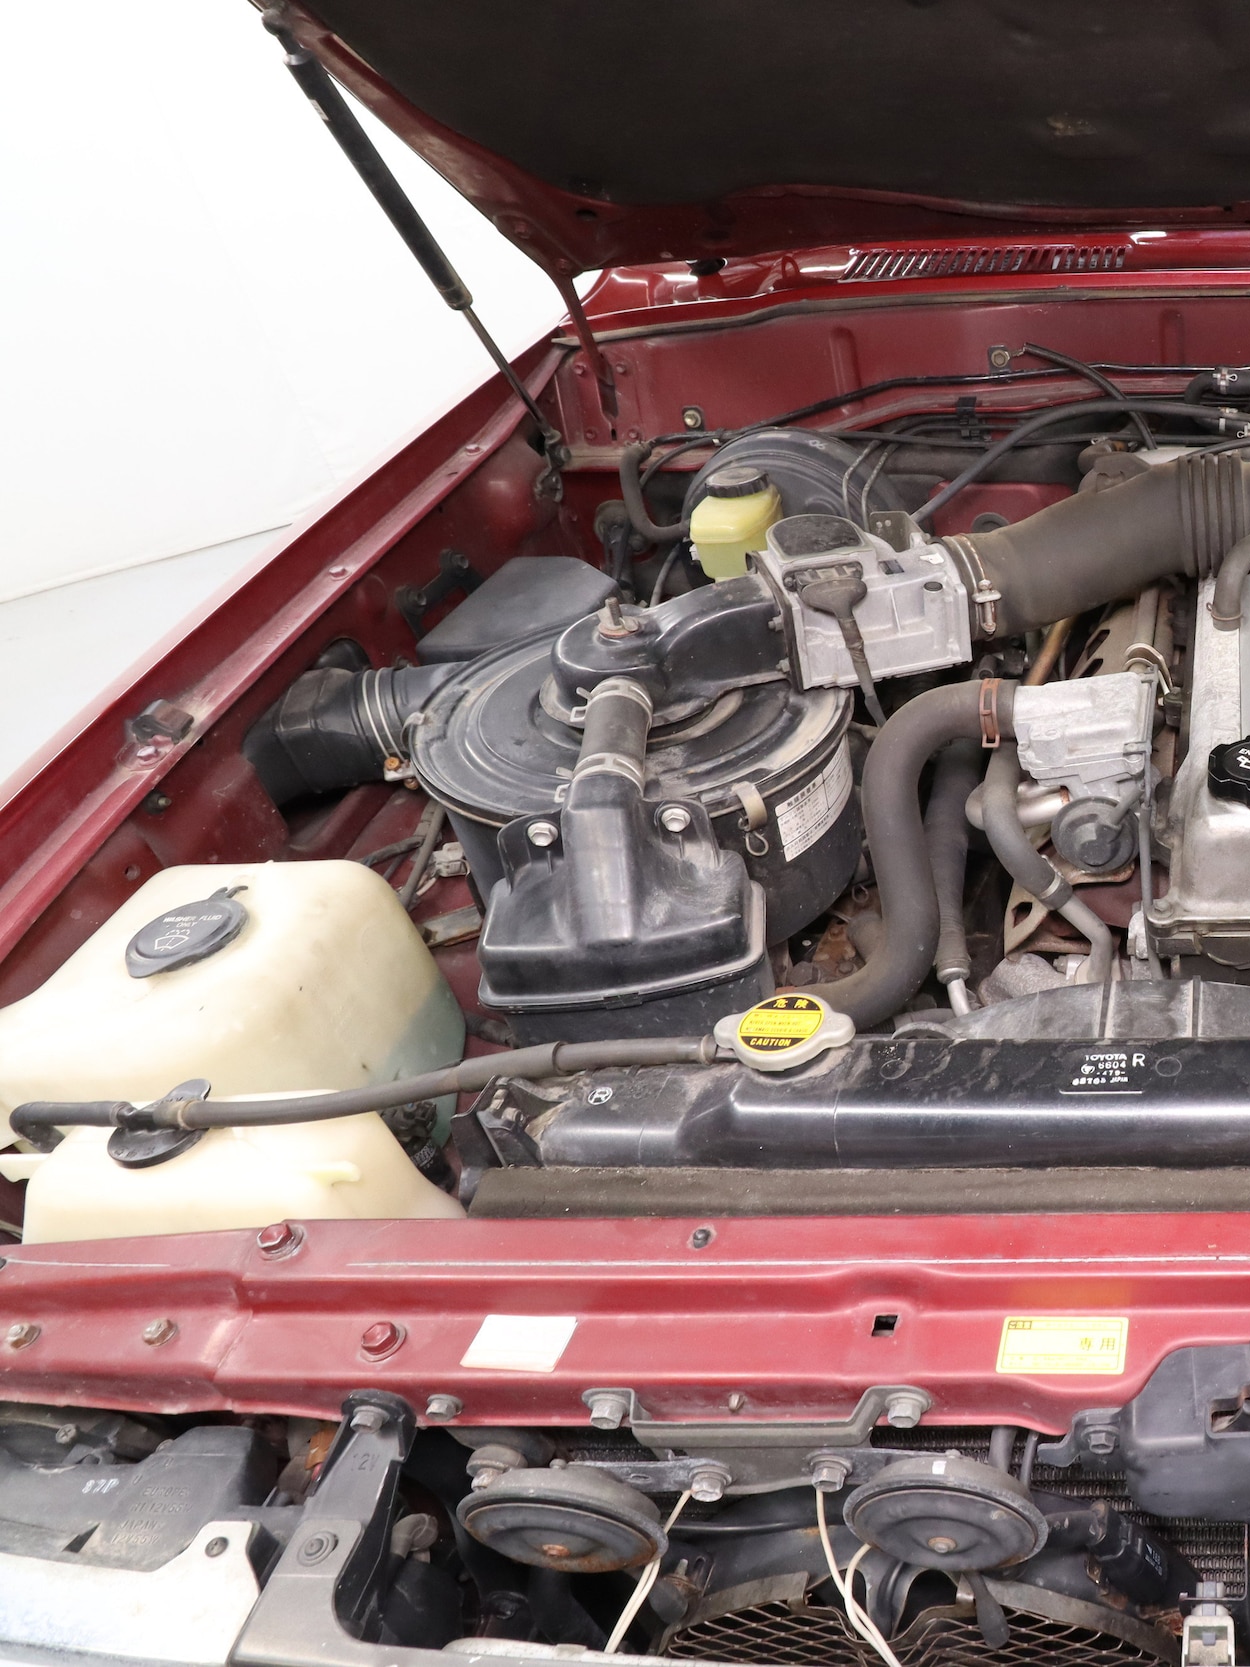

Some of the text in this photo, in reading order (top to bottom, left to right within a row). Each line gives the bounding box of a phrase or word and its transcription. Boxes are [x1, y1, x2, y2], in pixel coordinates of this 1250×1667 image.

[750, 1038, 792, 1047] CAUTION
[1085, 1053, 1146, 1067] TOYOTA R
